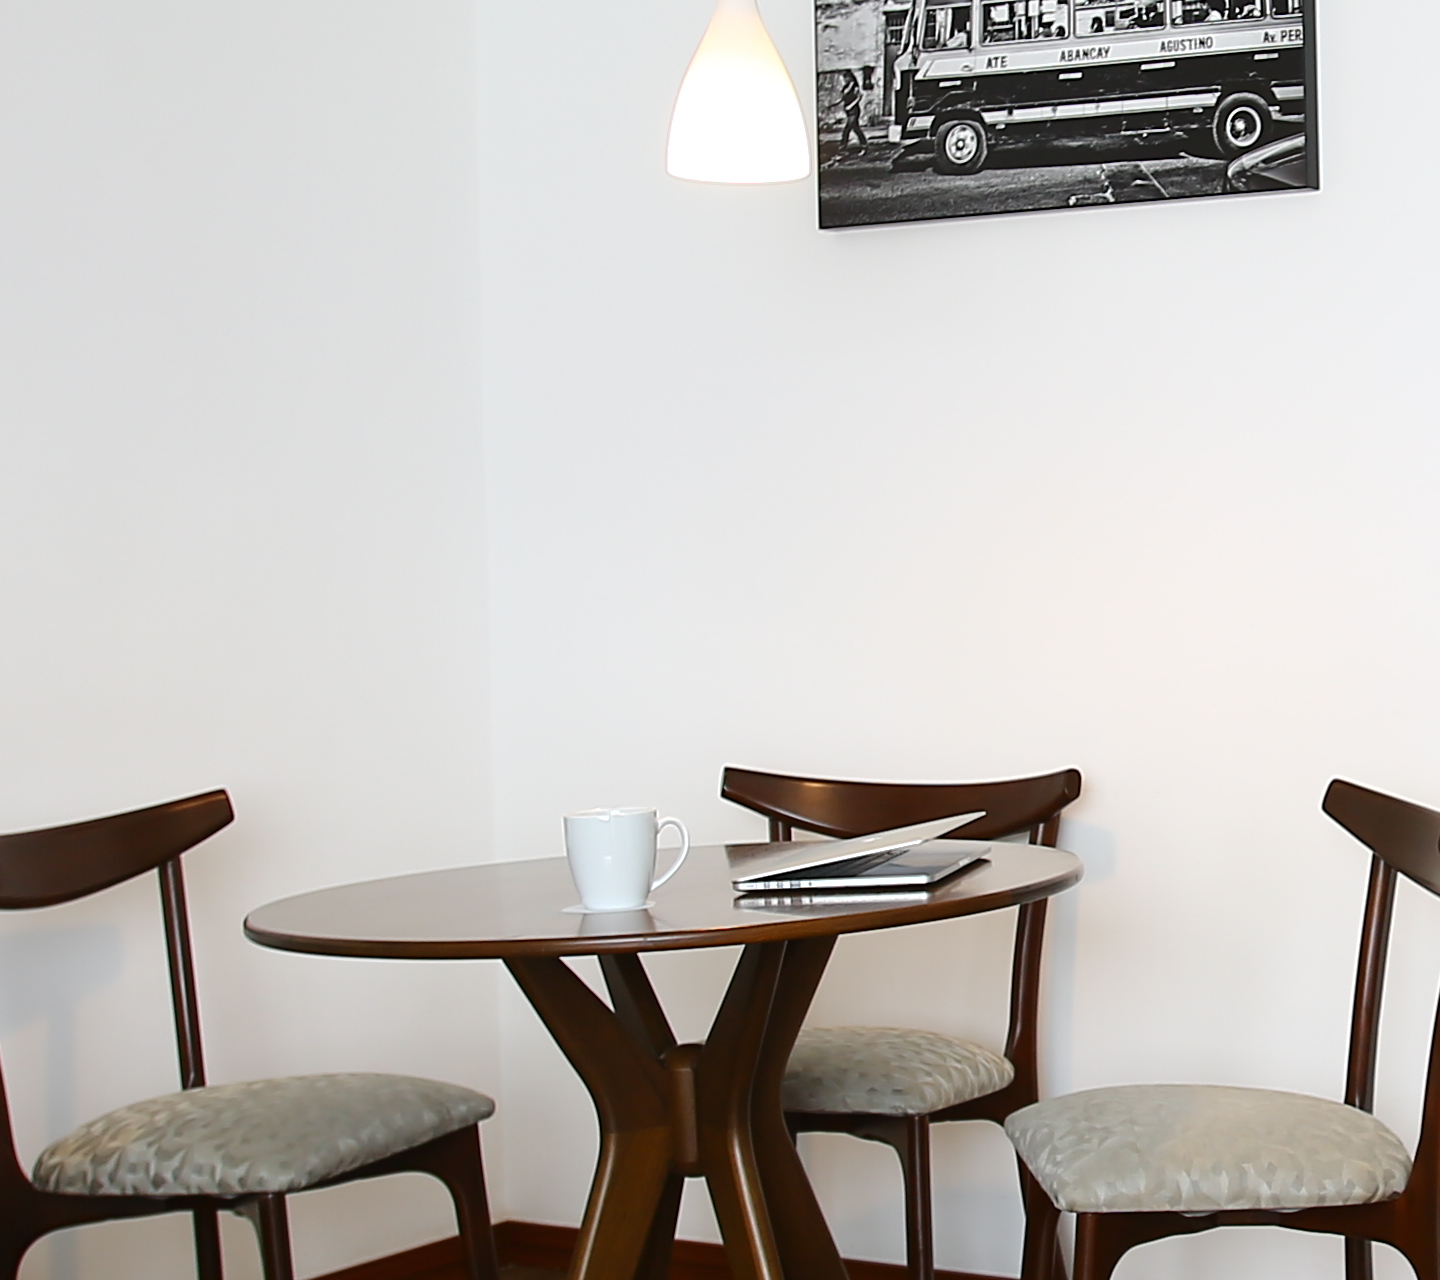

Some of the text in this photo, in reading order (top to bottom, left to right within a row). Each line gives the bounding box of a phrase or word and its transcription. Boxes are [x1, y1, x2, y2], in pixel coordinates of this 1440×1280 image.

[1280, 29, 1303, 42] PER
[1160, 36, 1214, 53] AGUSTINO
[1059, 46, 1111, 63] ABANCAY
[986, 56, 1008, 70] ATE
